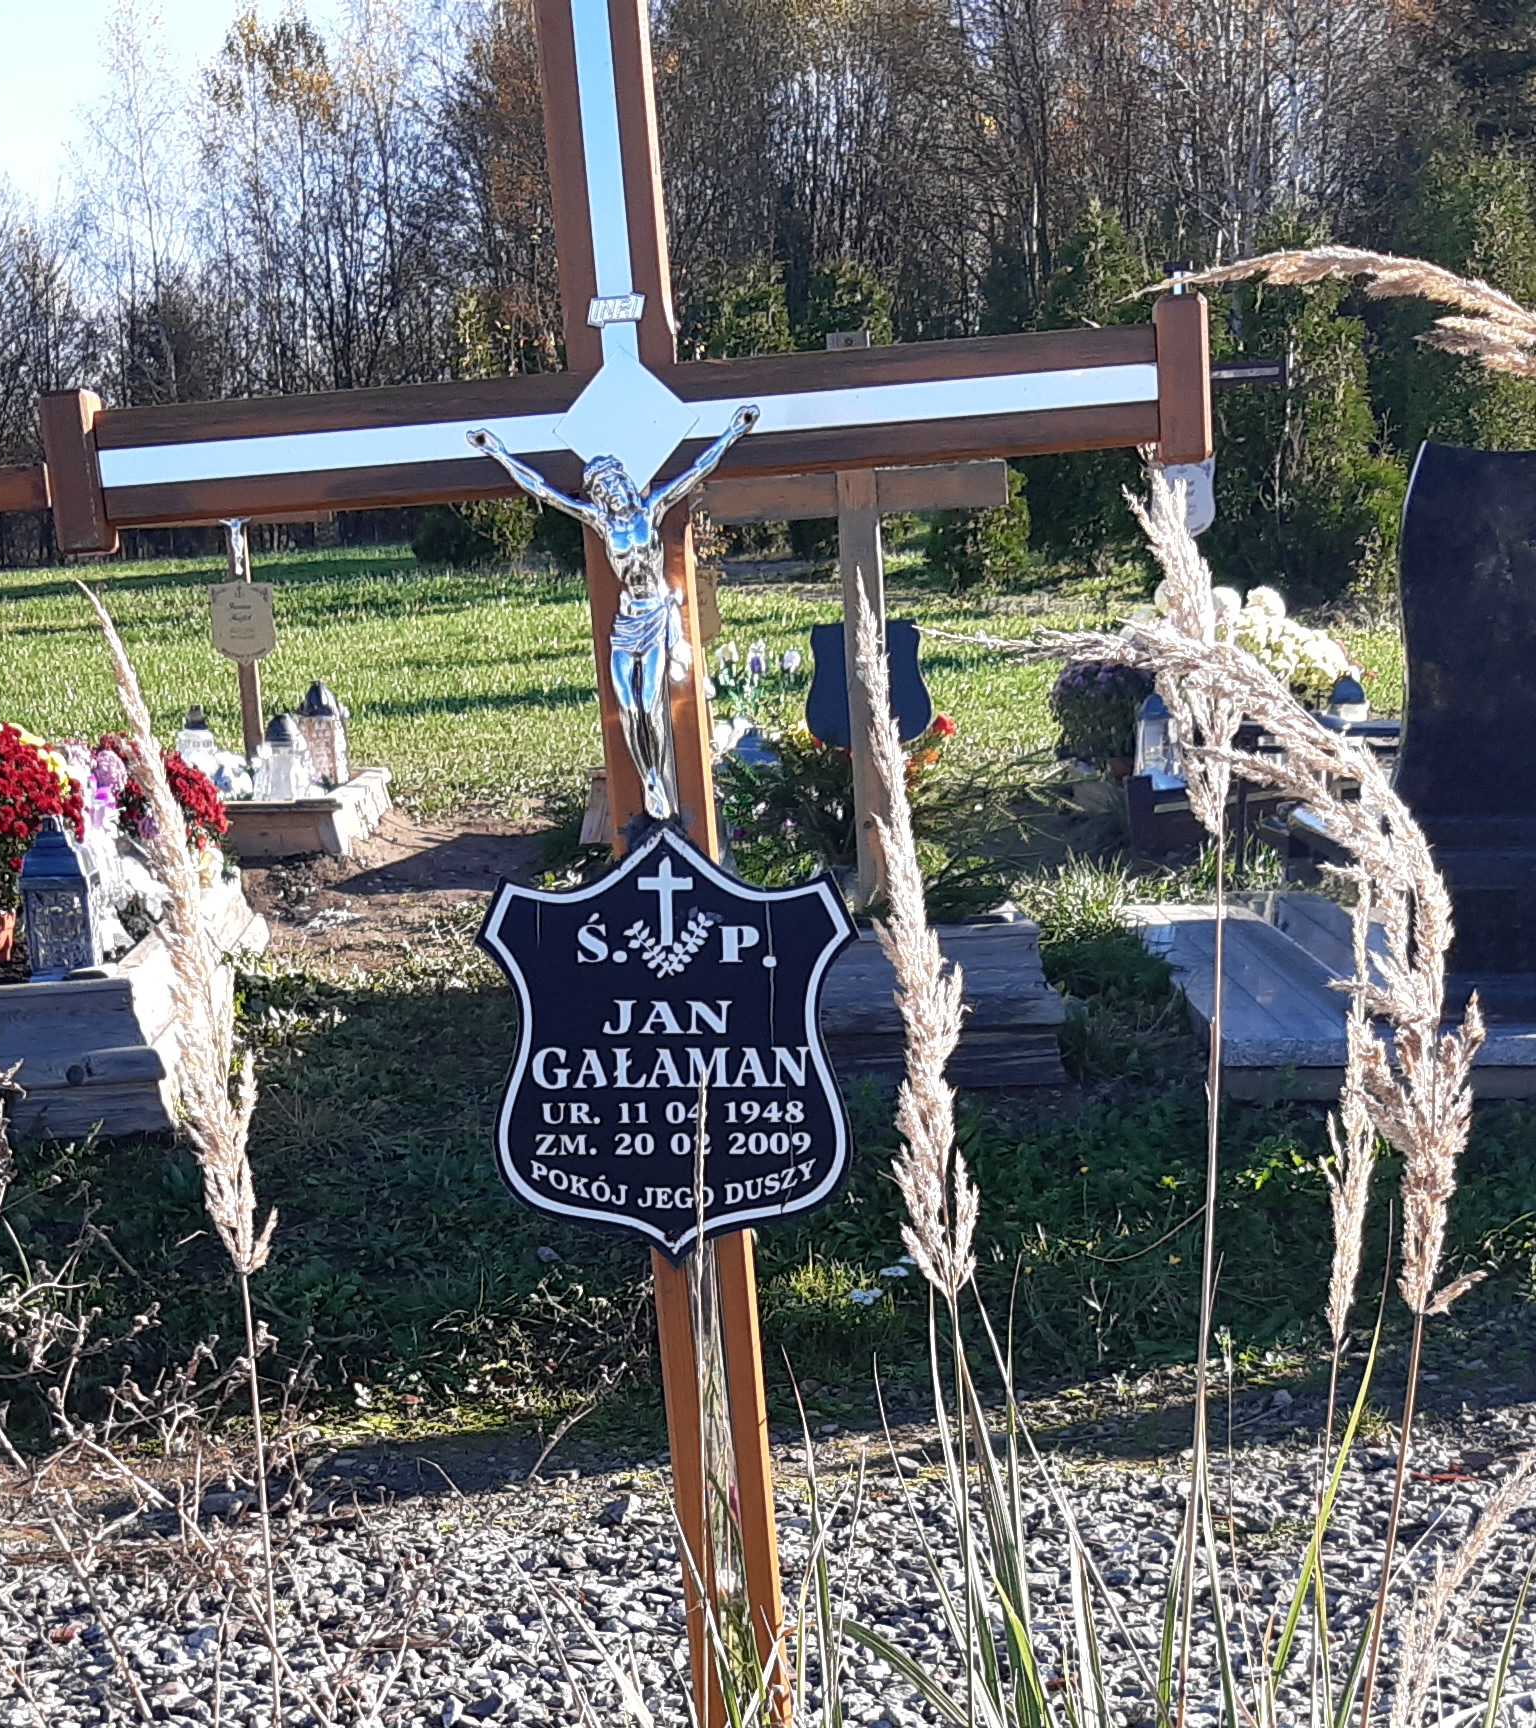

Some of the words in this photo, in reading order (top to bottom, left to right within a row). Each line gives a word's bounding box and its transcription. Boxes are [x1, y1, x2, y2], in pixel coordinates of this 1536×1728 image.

[593, 297, 639, 320] INRI
[577, 912, 627, 964] Ś.
[718, 925, 777, 968] P.
[602, 1000, 733, 1035] JAN
[531, 1046, 811, 1090] GAŁAMAN
[541, 1102, 601, 1125] UR.
[618, 1102, 649, 1124] 11
[724, 1101, 806, 1124] 1948
[534, 1133, 598, 1156] ZM.
[614, 1133, 655, 1155] 20
[729, 1133, 812, 1155] 2009
[530, 1160, 628, 1206] POKÓJ
[724, 1158, 817, 1206] DUSZY
